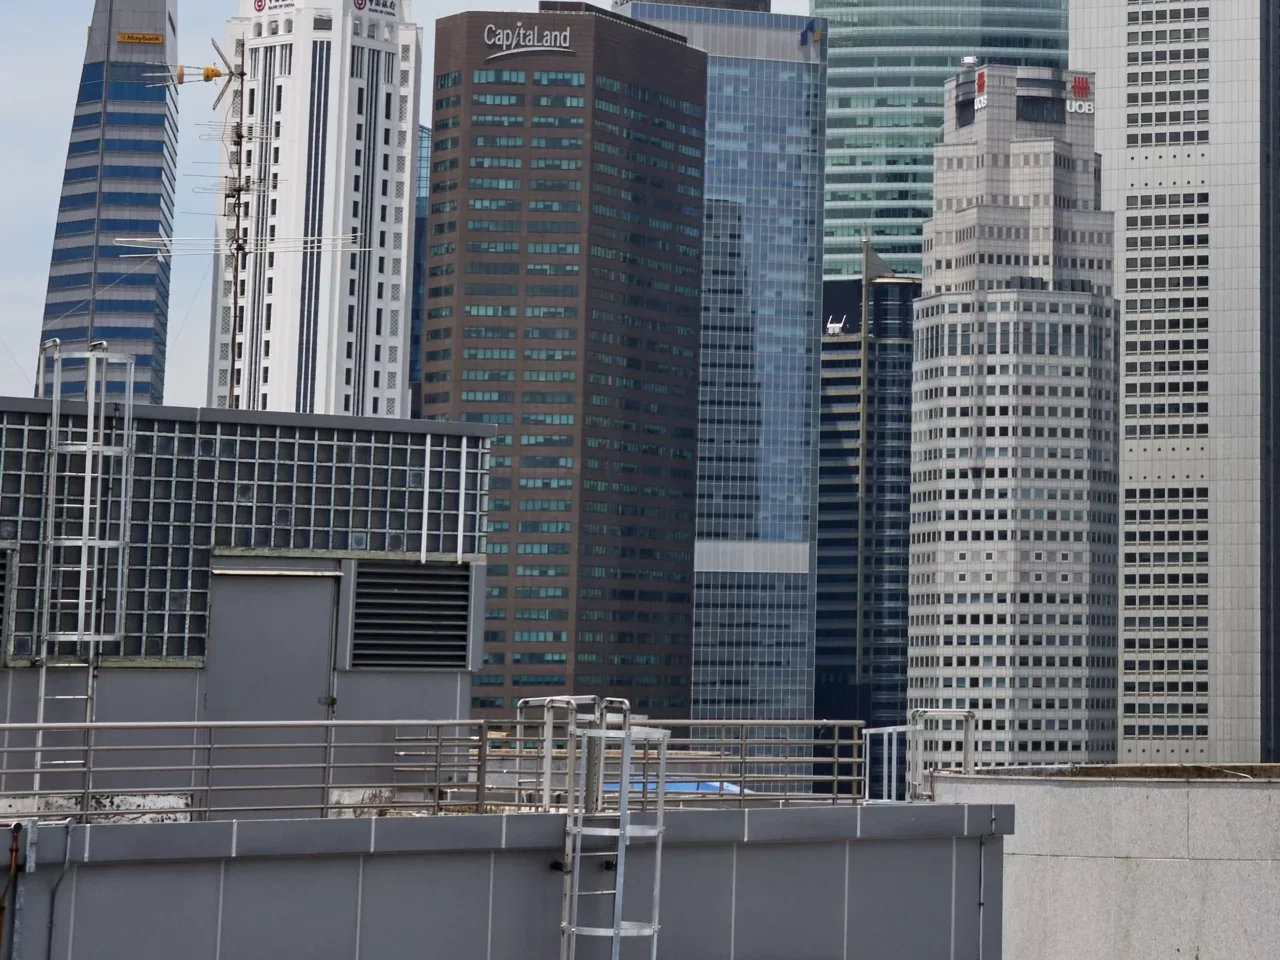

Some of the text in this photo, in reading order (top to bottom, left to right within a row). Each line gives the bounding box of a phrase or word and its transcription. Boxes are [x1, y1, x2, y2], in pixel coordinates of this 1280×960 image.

[484, 21, 570, 50] CapitaLand
[974, 95, 987, 110] UOB
[1066, 100, 1095, 114] UOB
